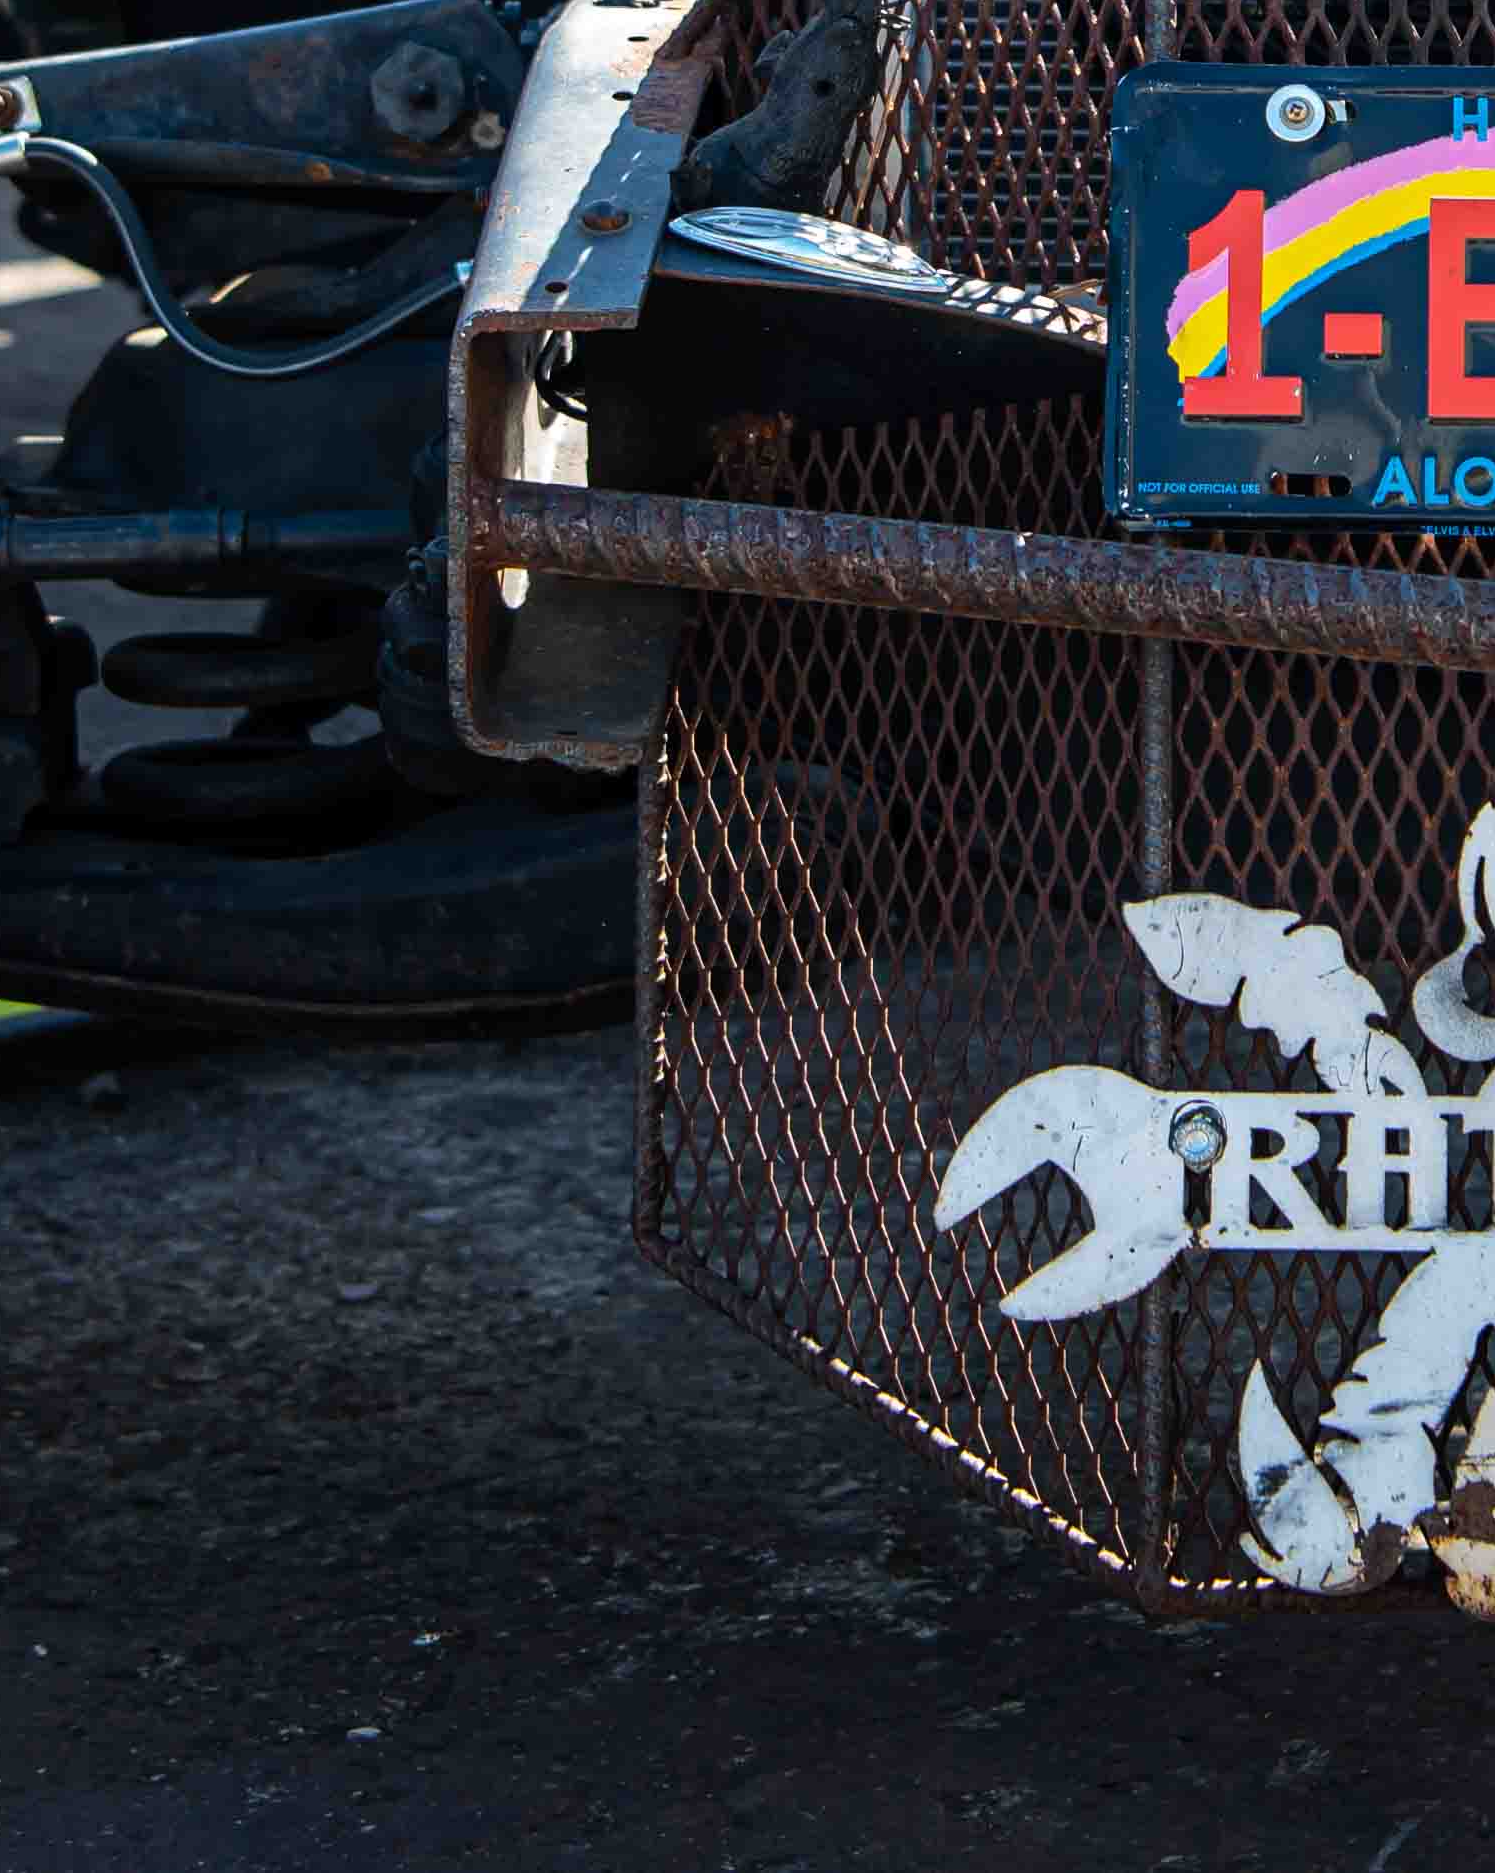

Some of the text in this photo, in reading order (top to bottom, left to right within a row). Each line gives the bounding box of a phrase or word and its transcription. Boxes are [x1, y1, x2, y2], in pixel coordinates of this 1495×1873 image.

[1138, 482, 1261, 494] NOT FOR OFFICIAL USE
